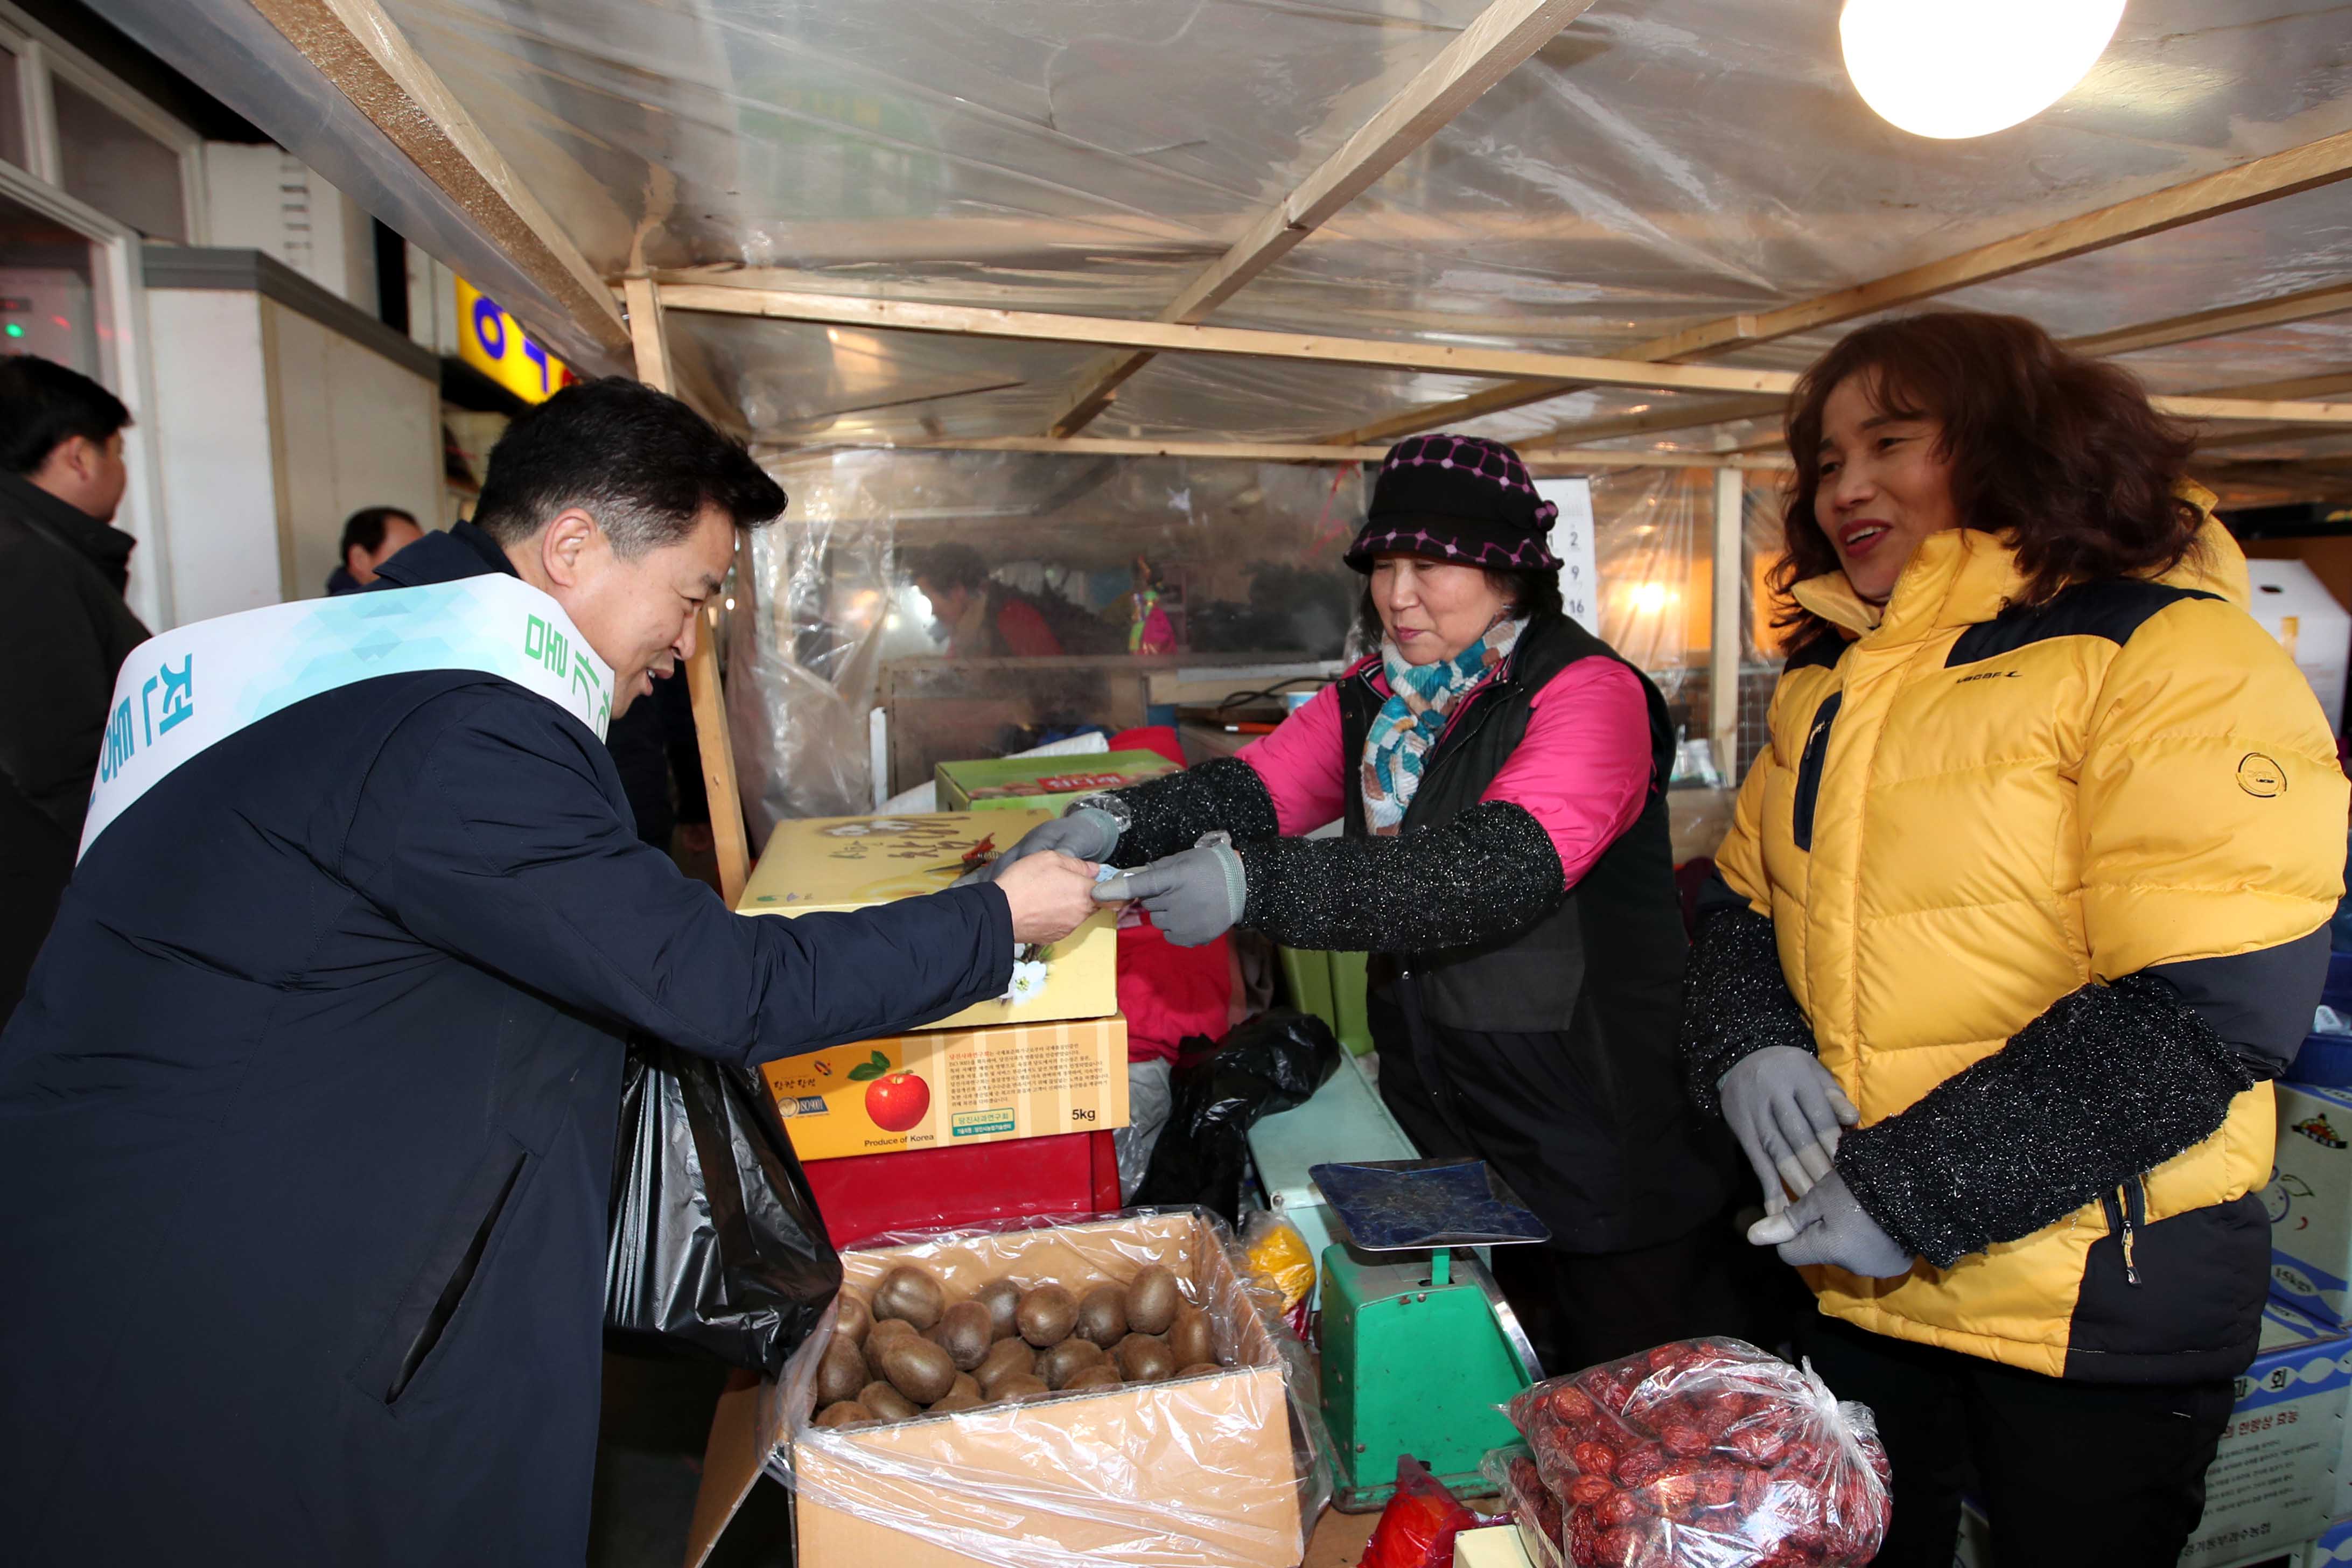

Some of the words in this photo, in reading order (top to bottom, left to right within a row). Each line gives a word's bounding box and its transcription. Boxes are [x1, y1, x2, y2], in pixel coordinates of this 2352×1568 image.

[1570, 531, 1578, 547] 2
[1571, 566, 1579, 580] 9
[1570, 599, 1584, 613] 16
[88, 653, 193, 810] 전통
[1072, 1109, 1096, 1121] 5kg
[864, 1138, 898, 1146] Produce
